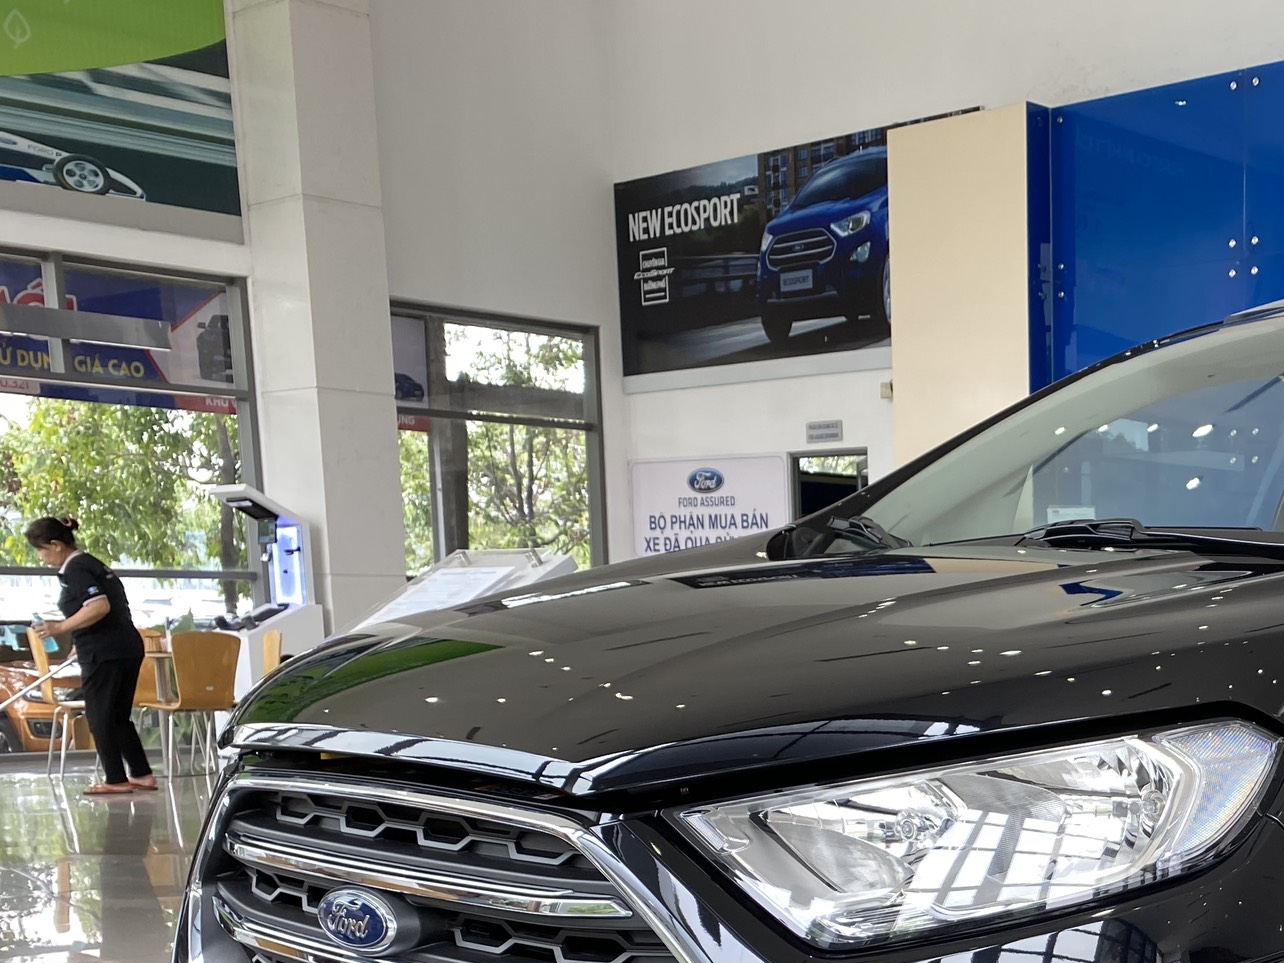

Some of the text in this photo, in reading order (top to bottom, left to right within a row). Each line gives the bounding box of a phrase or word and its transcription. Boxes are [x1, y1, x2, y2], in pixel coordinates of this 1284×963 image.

[628, 193, 741, 242] NEW ECOSPORT
[74, 353, 104, 374] GIÁ
[108, 359, 146, 378] CAO
[678, 495, 736, 508] FORD ASSURED
[649, 508, 769, 535] BỘ PHẬN MUA BÁN
[644, 537, 661, 553] XE
[664, 533, 681, 551] ĐÃ
[327, 899, 370, 939] Ford
